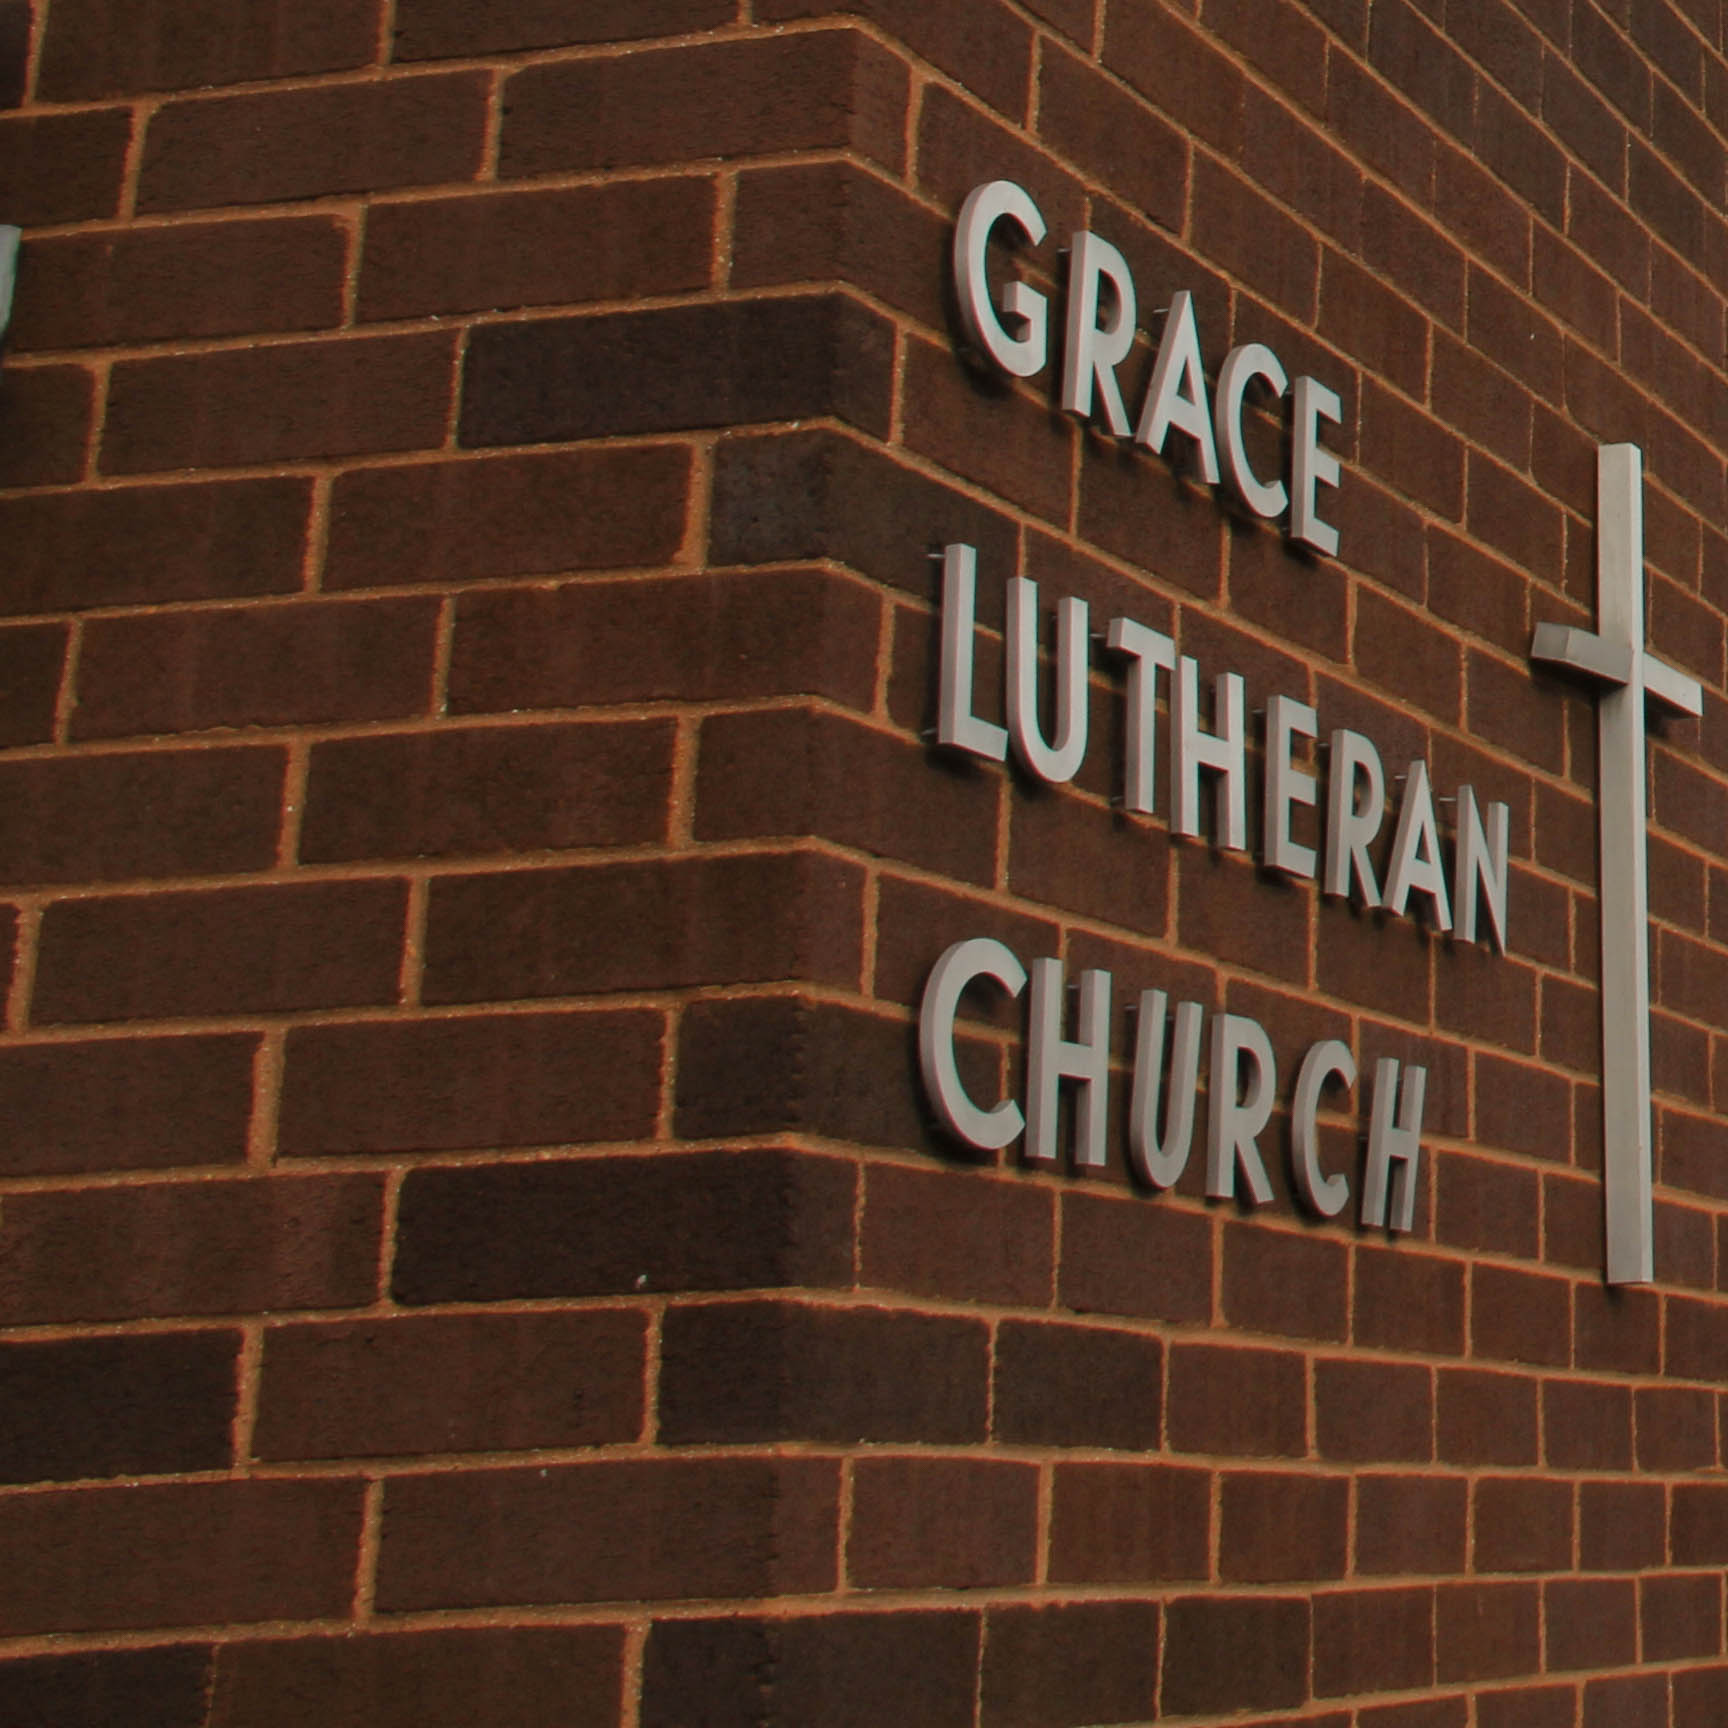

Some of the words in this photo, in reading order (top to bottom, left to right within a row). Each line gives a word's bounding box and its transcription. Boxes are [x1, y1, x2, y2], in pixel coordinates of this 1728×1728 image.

[953, 179, 1342, 558] GRACE
[937, 542, 1510, 955] LUTHERAN
[919, 937, 1427, 1233] CHURCH
